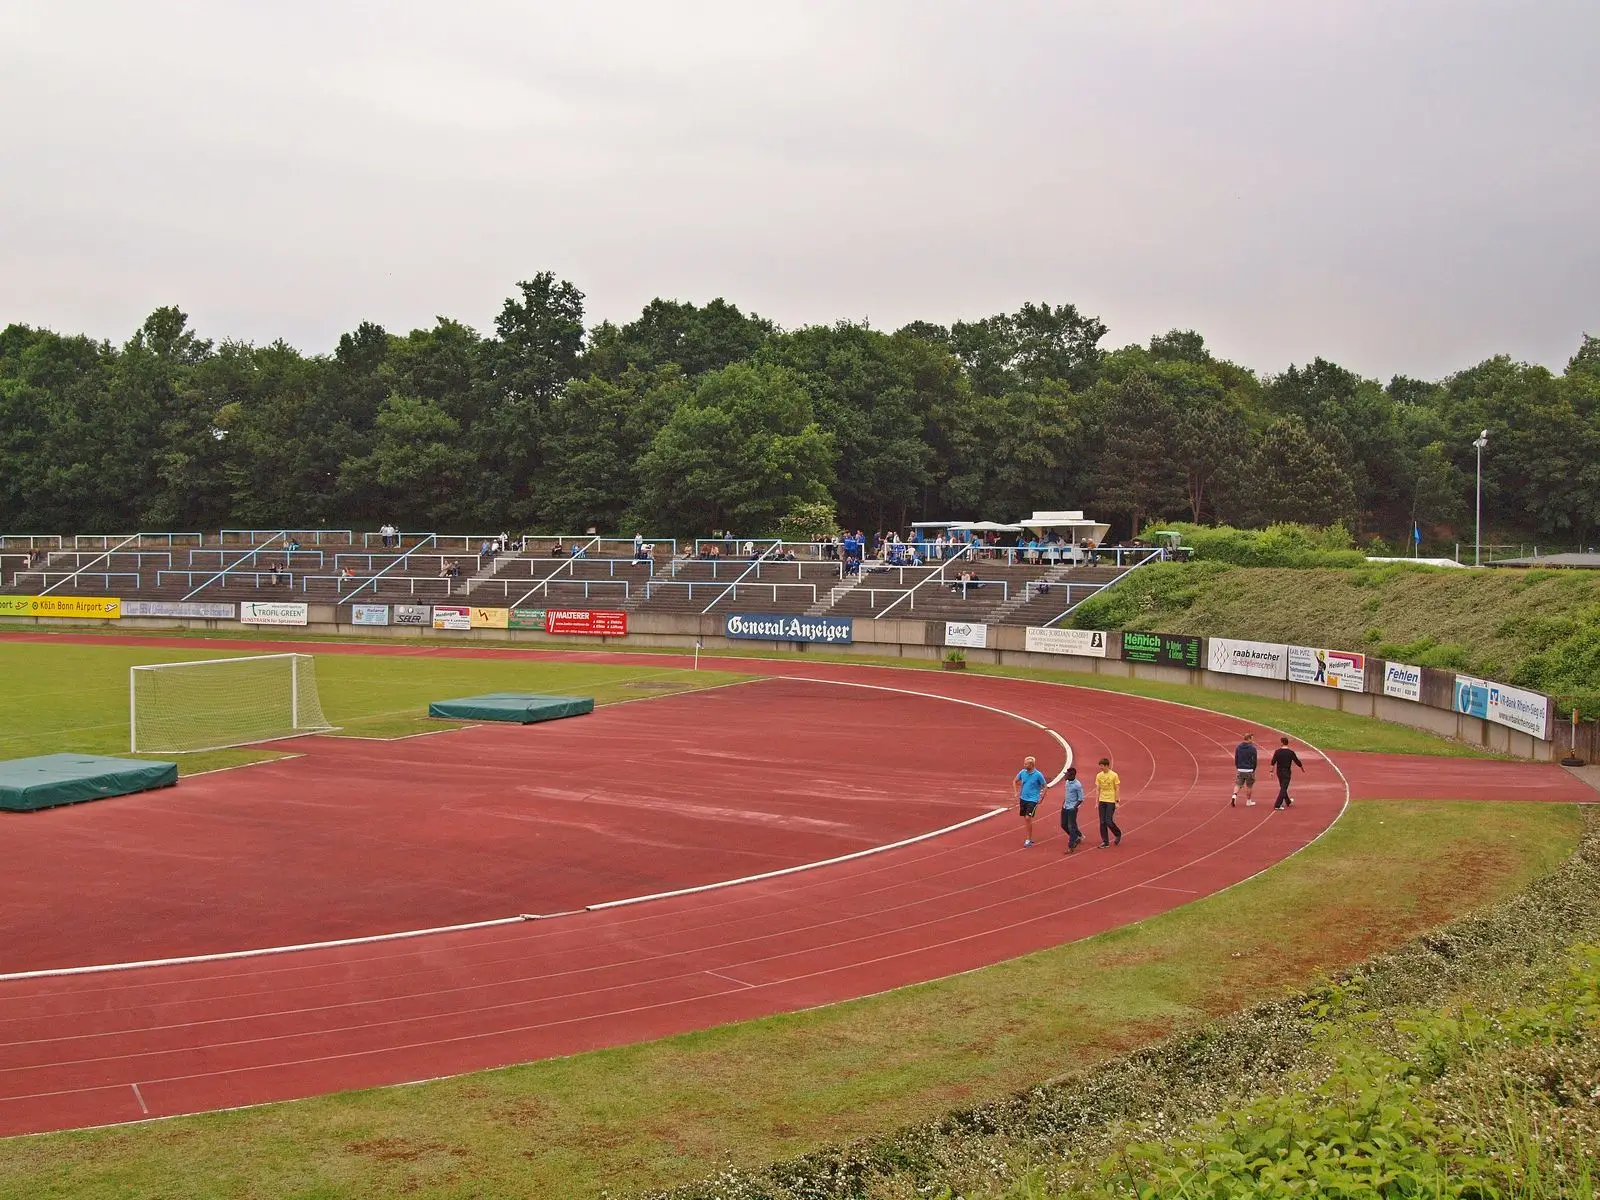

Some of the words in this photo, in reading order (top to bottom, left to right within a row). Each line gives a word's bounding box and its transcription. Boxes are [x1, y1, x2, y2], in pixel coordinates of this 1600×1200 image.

[40, 601, 55, 610] Köln
[57, 602, 74, 610] Bonn
[76, 602, 102, 612] Airport
[555, 611, 590, 620] MALTERER
[727, 616, 850, 642] General-Anzeiger
[1048, 630, 1070, 638] JORDAN
[1124, 632, 1161, 647] Henrich
[1232, 649, 1251, 658] raab
[1251, 650, 1280, 661] karcher
[1387, 668, 1419, 683] Fehlen
